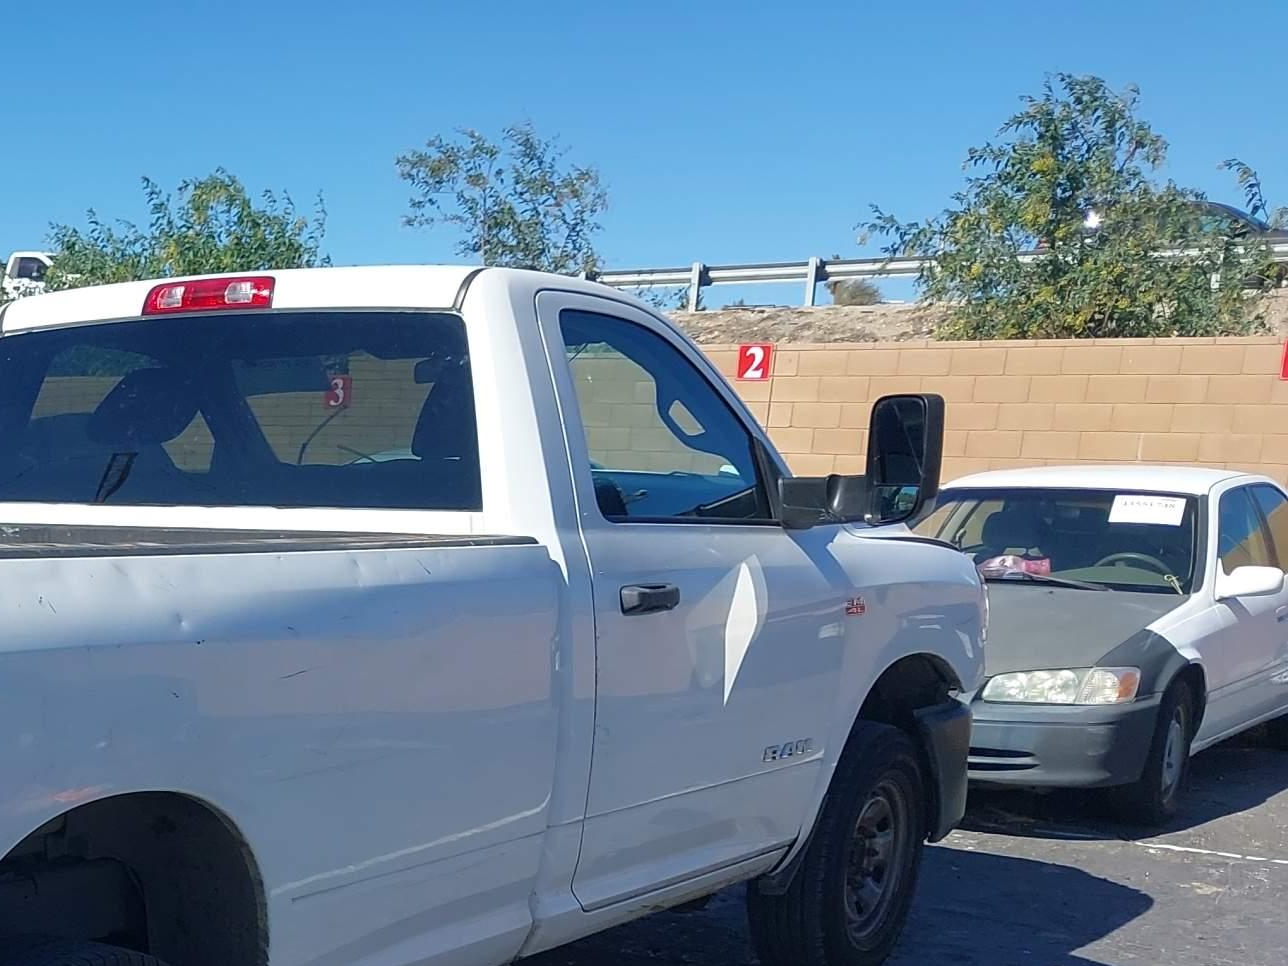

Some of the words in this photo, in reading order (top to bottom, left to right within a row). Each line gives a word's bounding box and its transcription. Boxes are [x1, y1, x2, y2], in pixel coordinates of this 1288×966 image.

[743, 346, 765, 379] 2
[329, 378, 344, 406] 3
[763, 738, 813, 762] RAM
